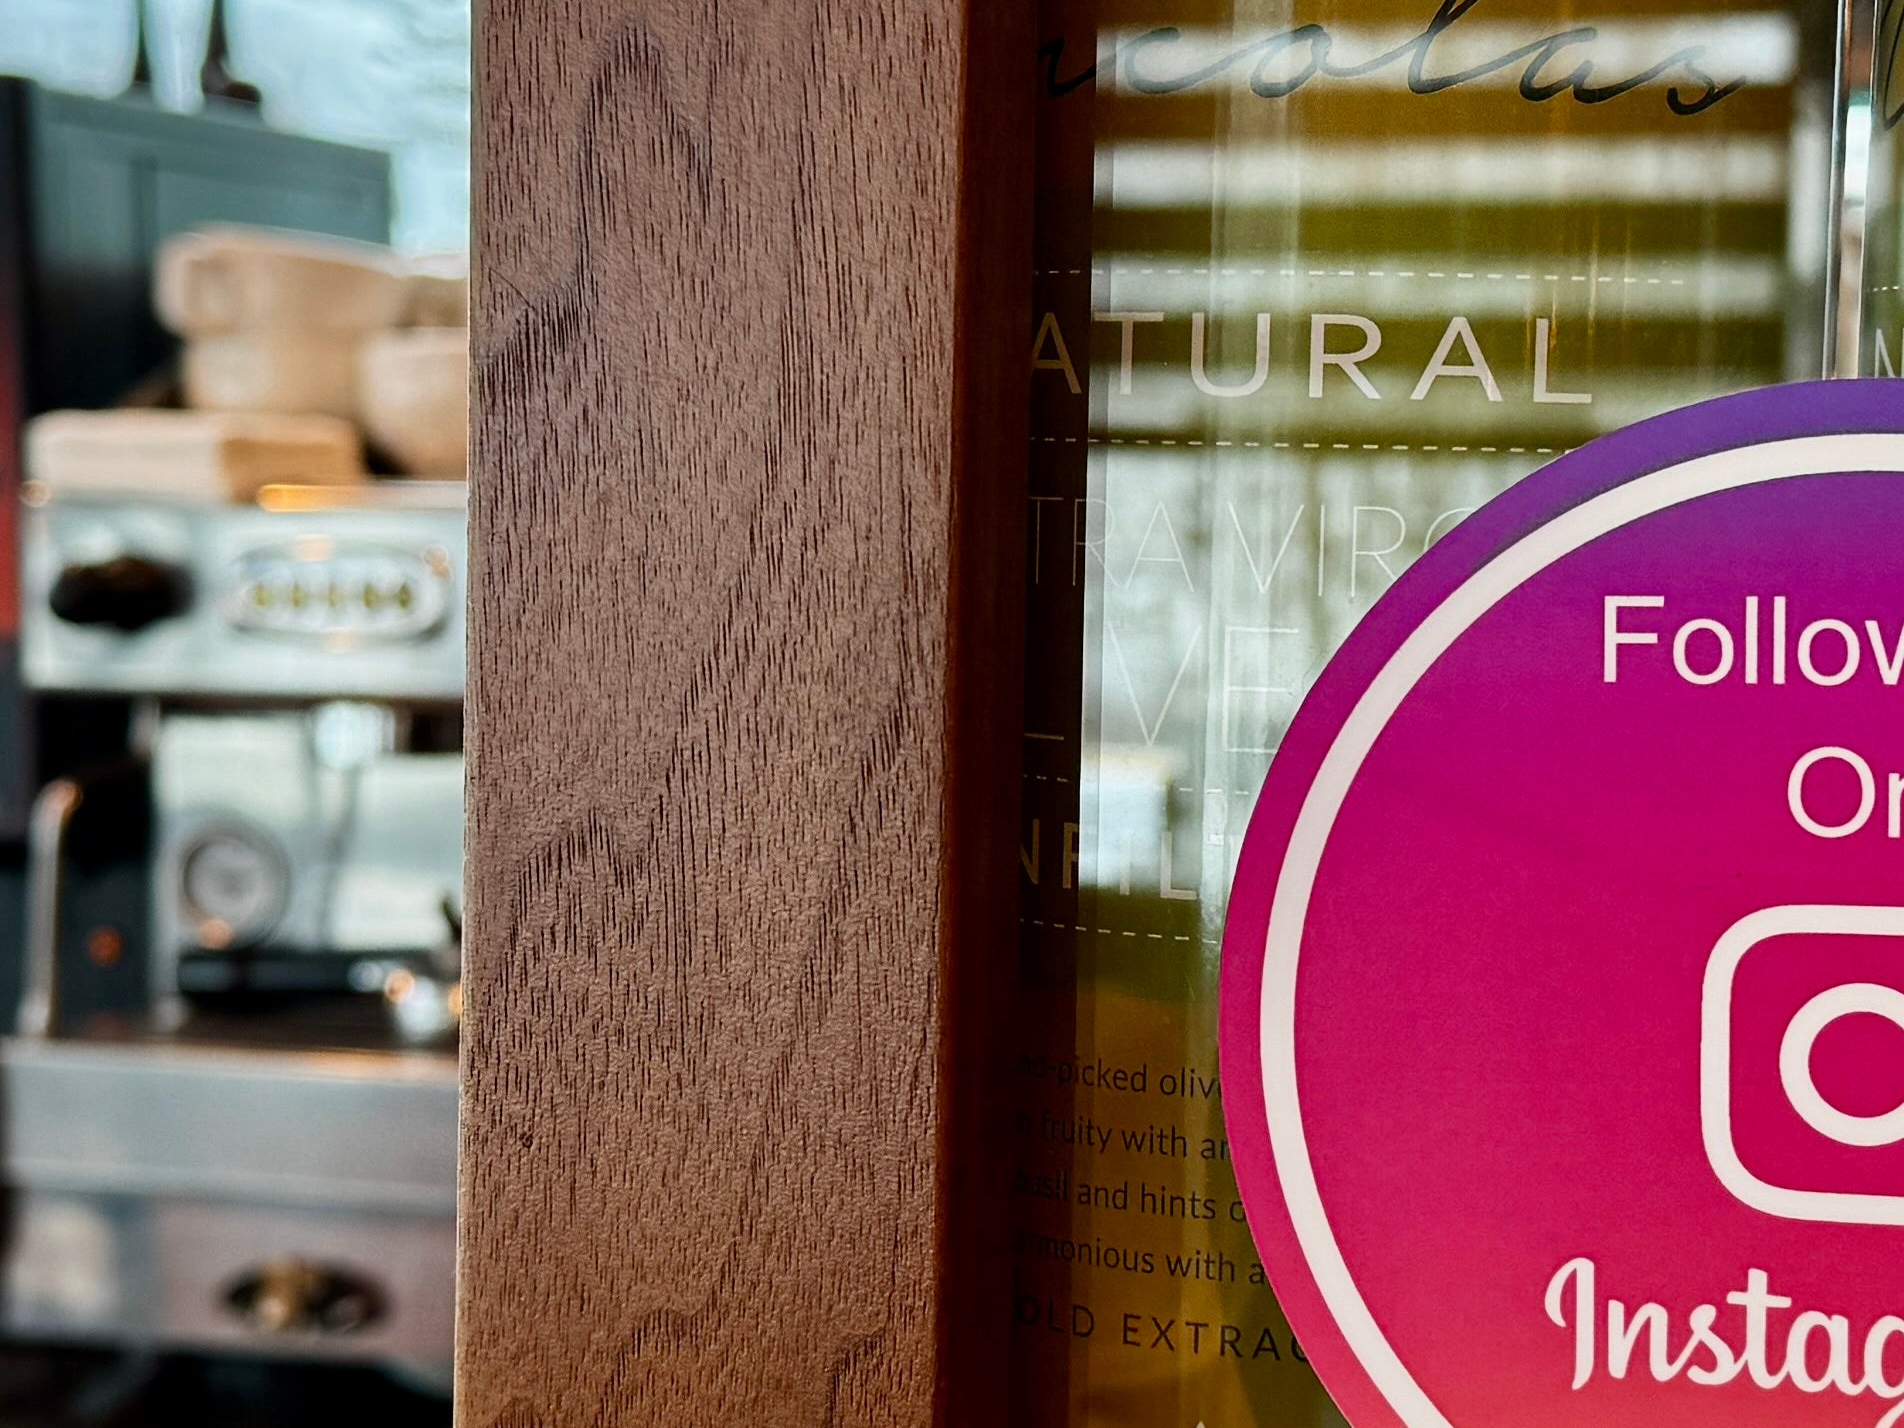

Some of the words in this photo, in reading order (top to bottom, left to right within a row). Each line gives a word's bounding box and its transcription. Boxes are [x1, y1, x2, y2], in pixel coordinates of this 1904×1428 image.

[1031, 311, 1594, 405] ATURAL
[1029, 496, 1194, 593] TRA
[1159, 1067, 1221, 1099] oliv
[1041, 1109, 1113, 1154] fruity
[1122, 1123, 1188, 1158] with
[1078, 1181, 1129, 1212] and
[1140, 1184, 1217, 1221] hints
[1165, 1248, 1236, 1283] with
[1017, 1293, 1095, 1338] OLD
